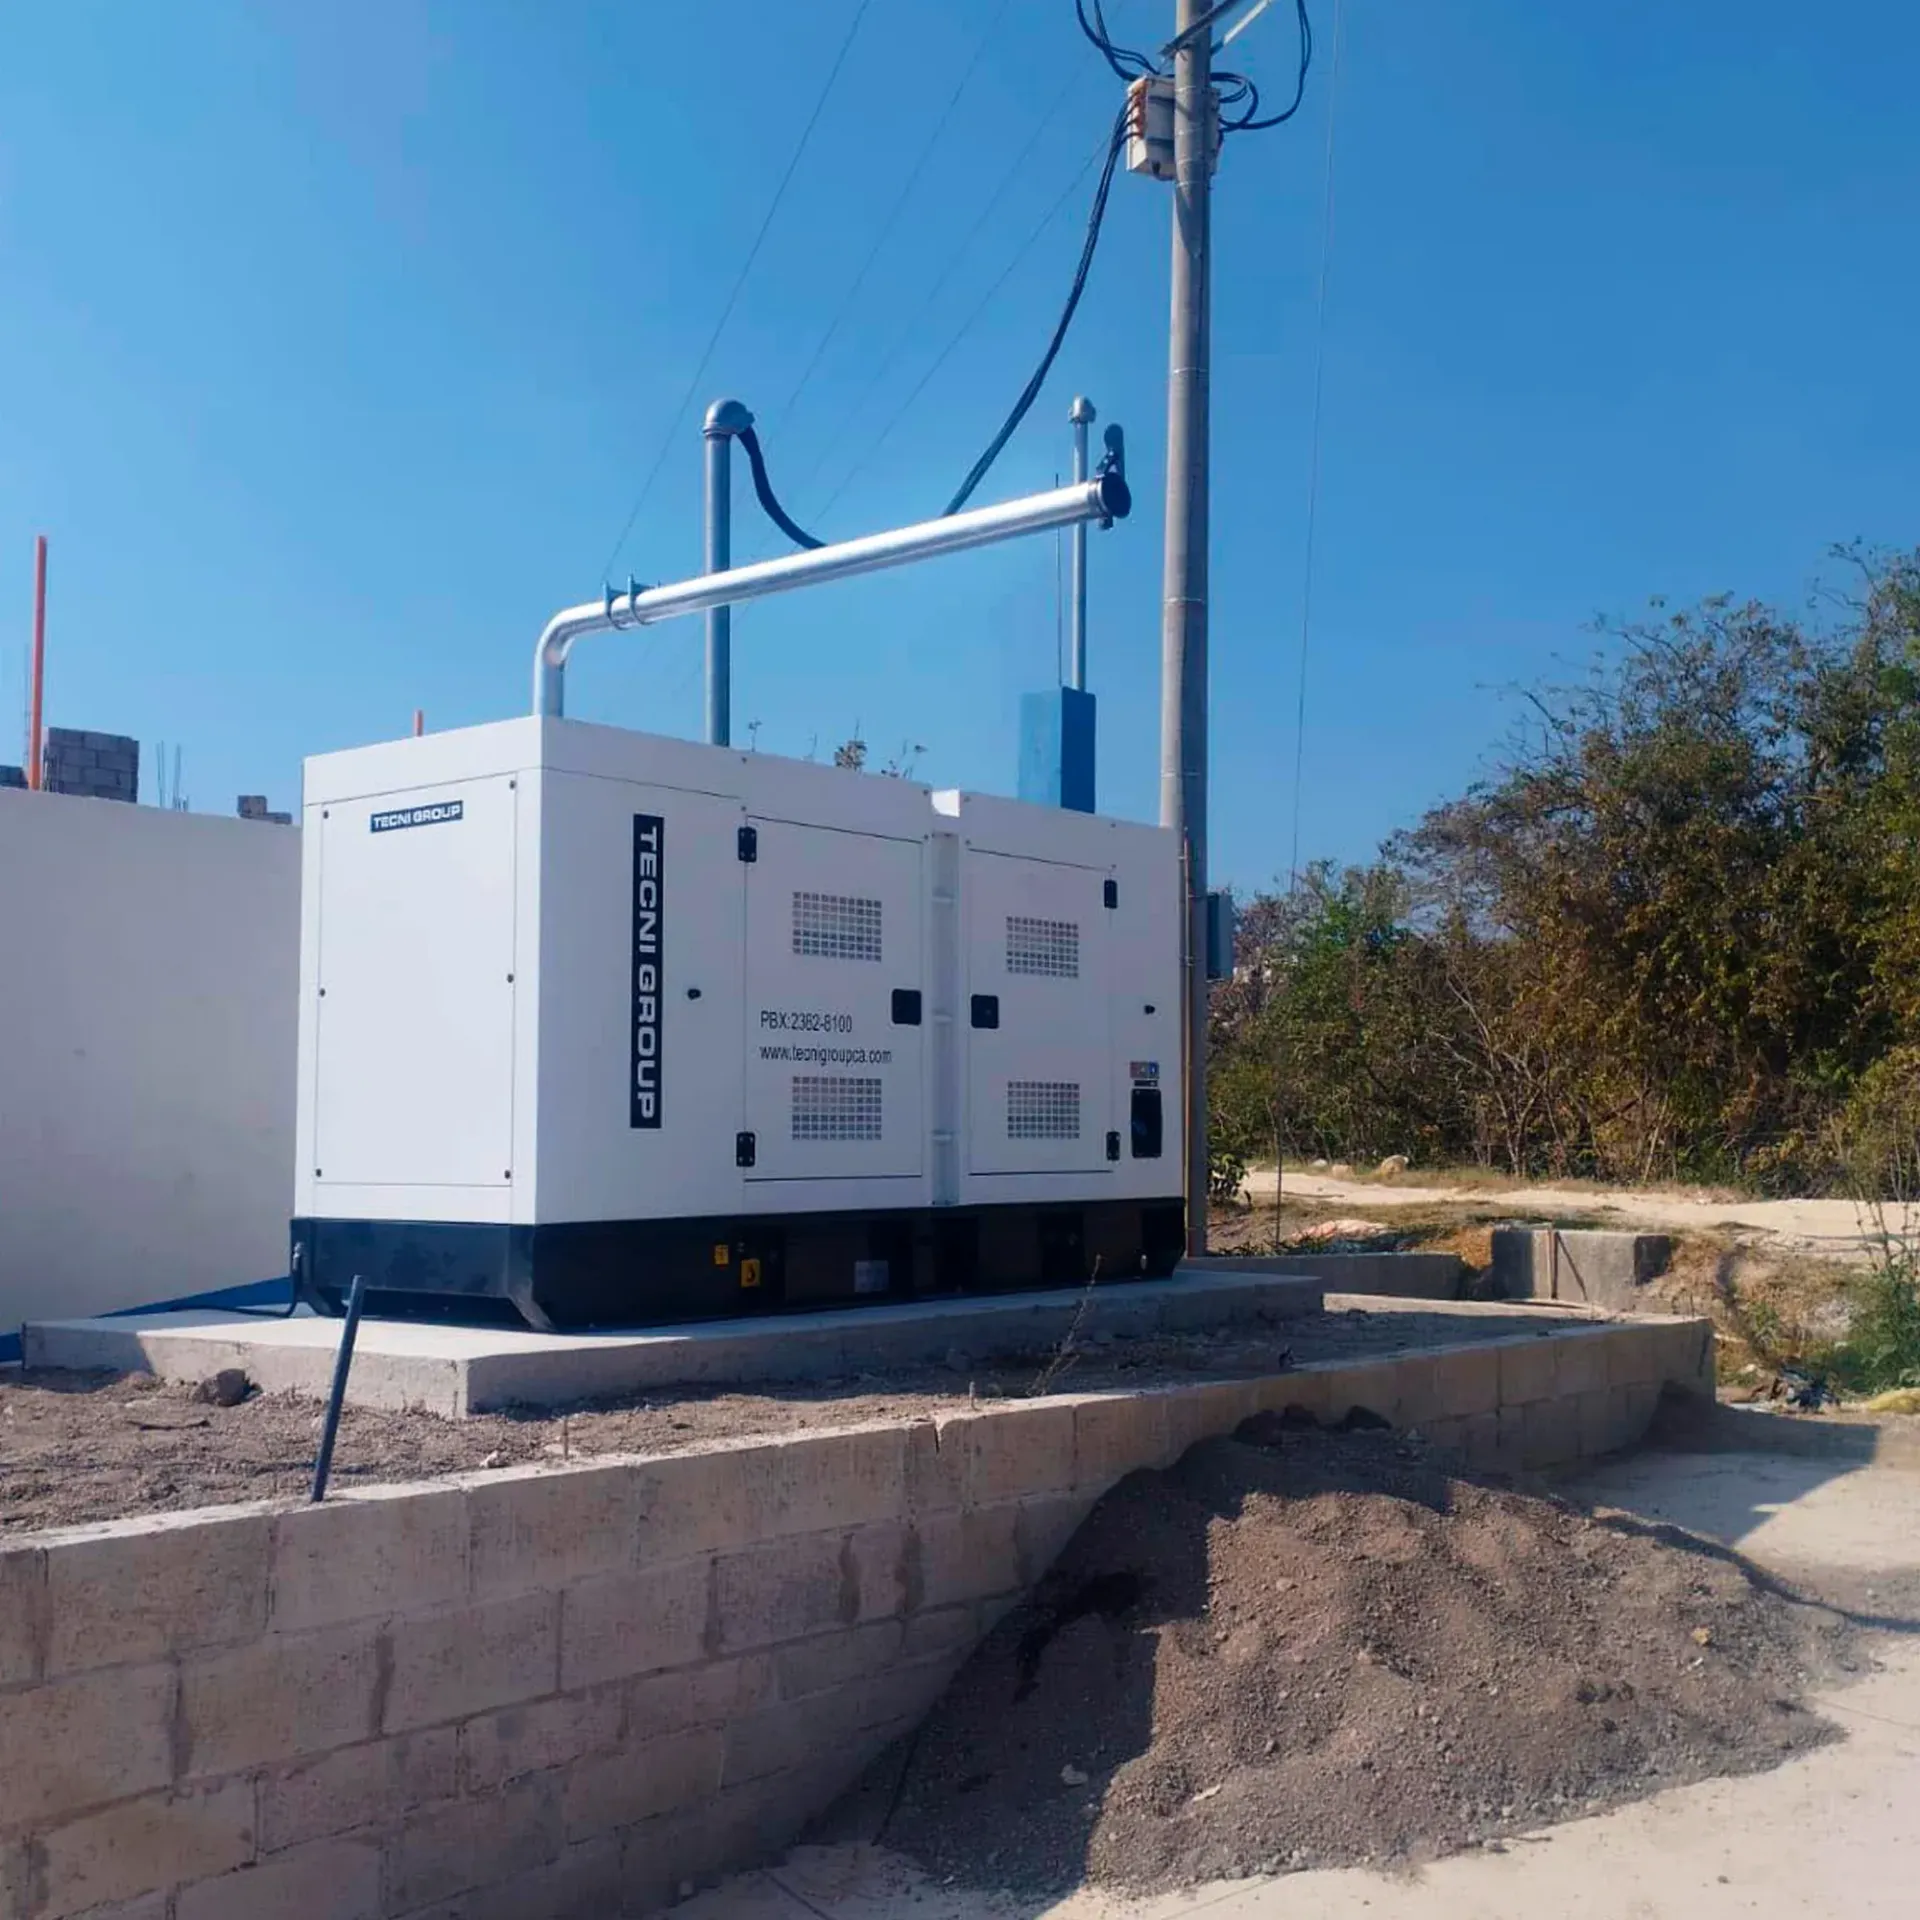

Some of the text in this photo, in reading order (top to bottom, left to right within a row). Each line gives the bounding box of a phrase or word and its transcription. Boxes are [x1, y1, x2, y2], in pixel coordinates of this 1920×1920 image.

[373, 804, 461, 829] TECNI GROUP
[637, 826, 658, 1119] TECNI GROUP
[759, 1042, 893, 1067] www.tecnigroupca.com
